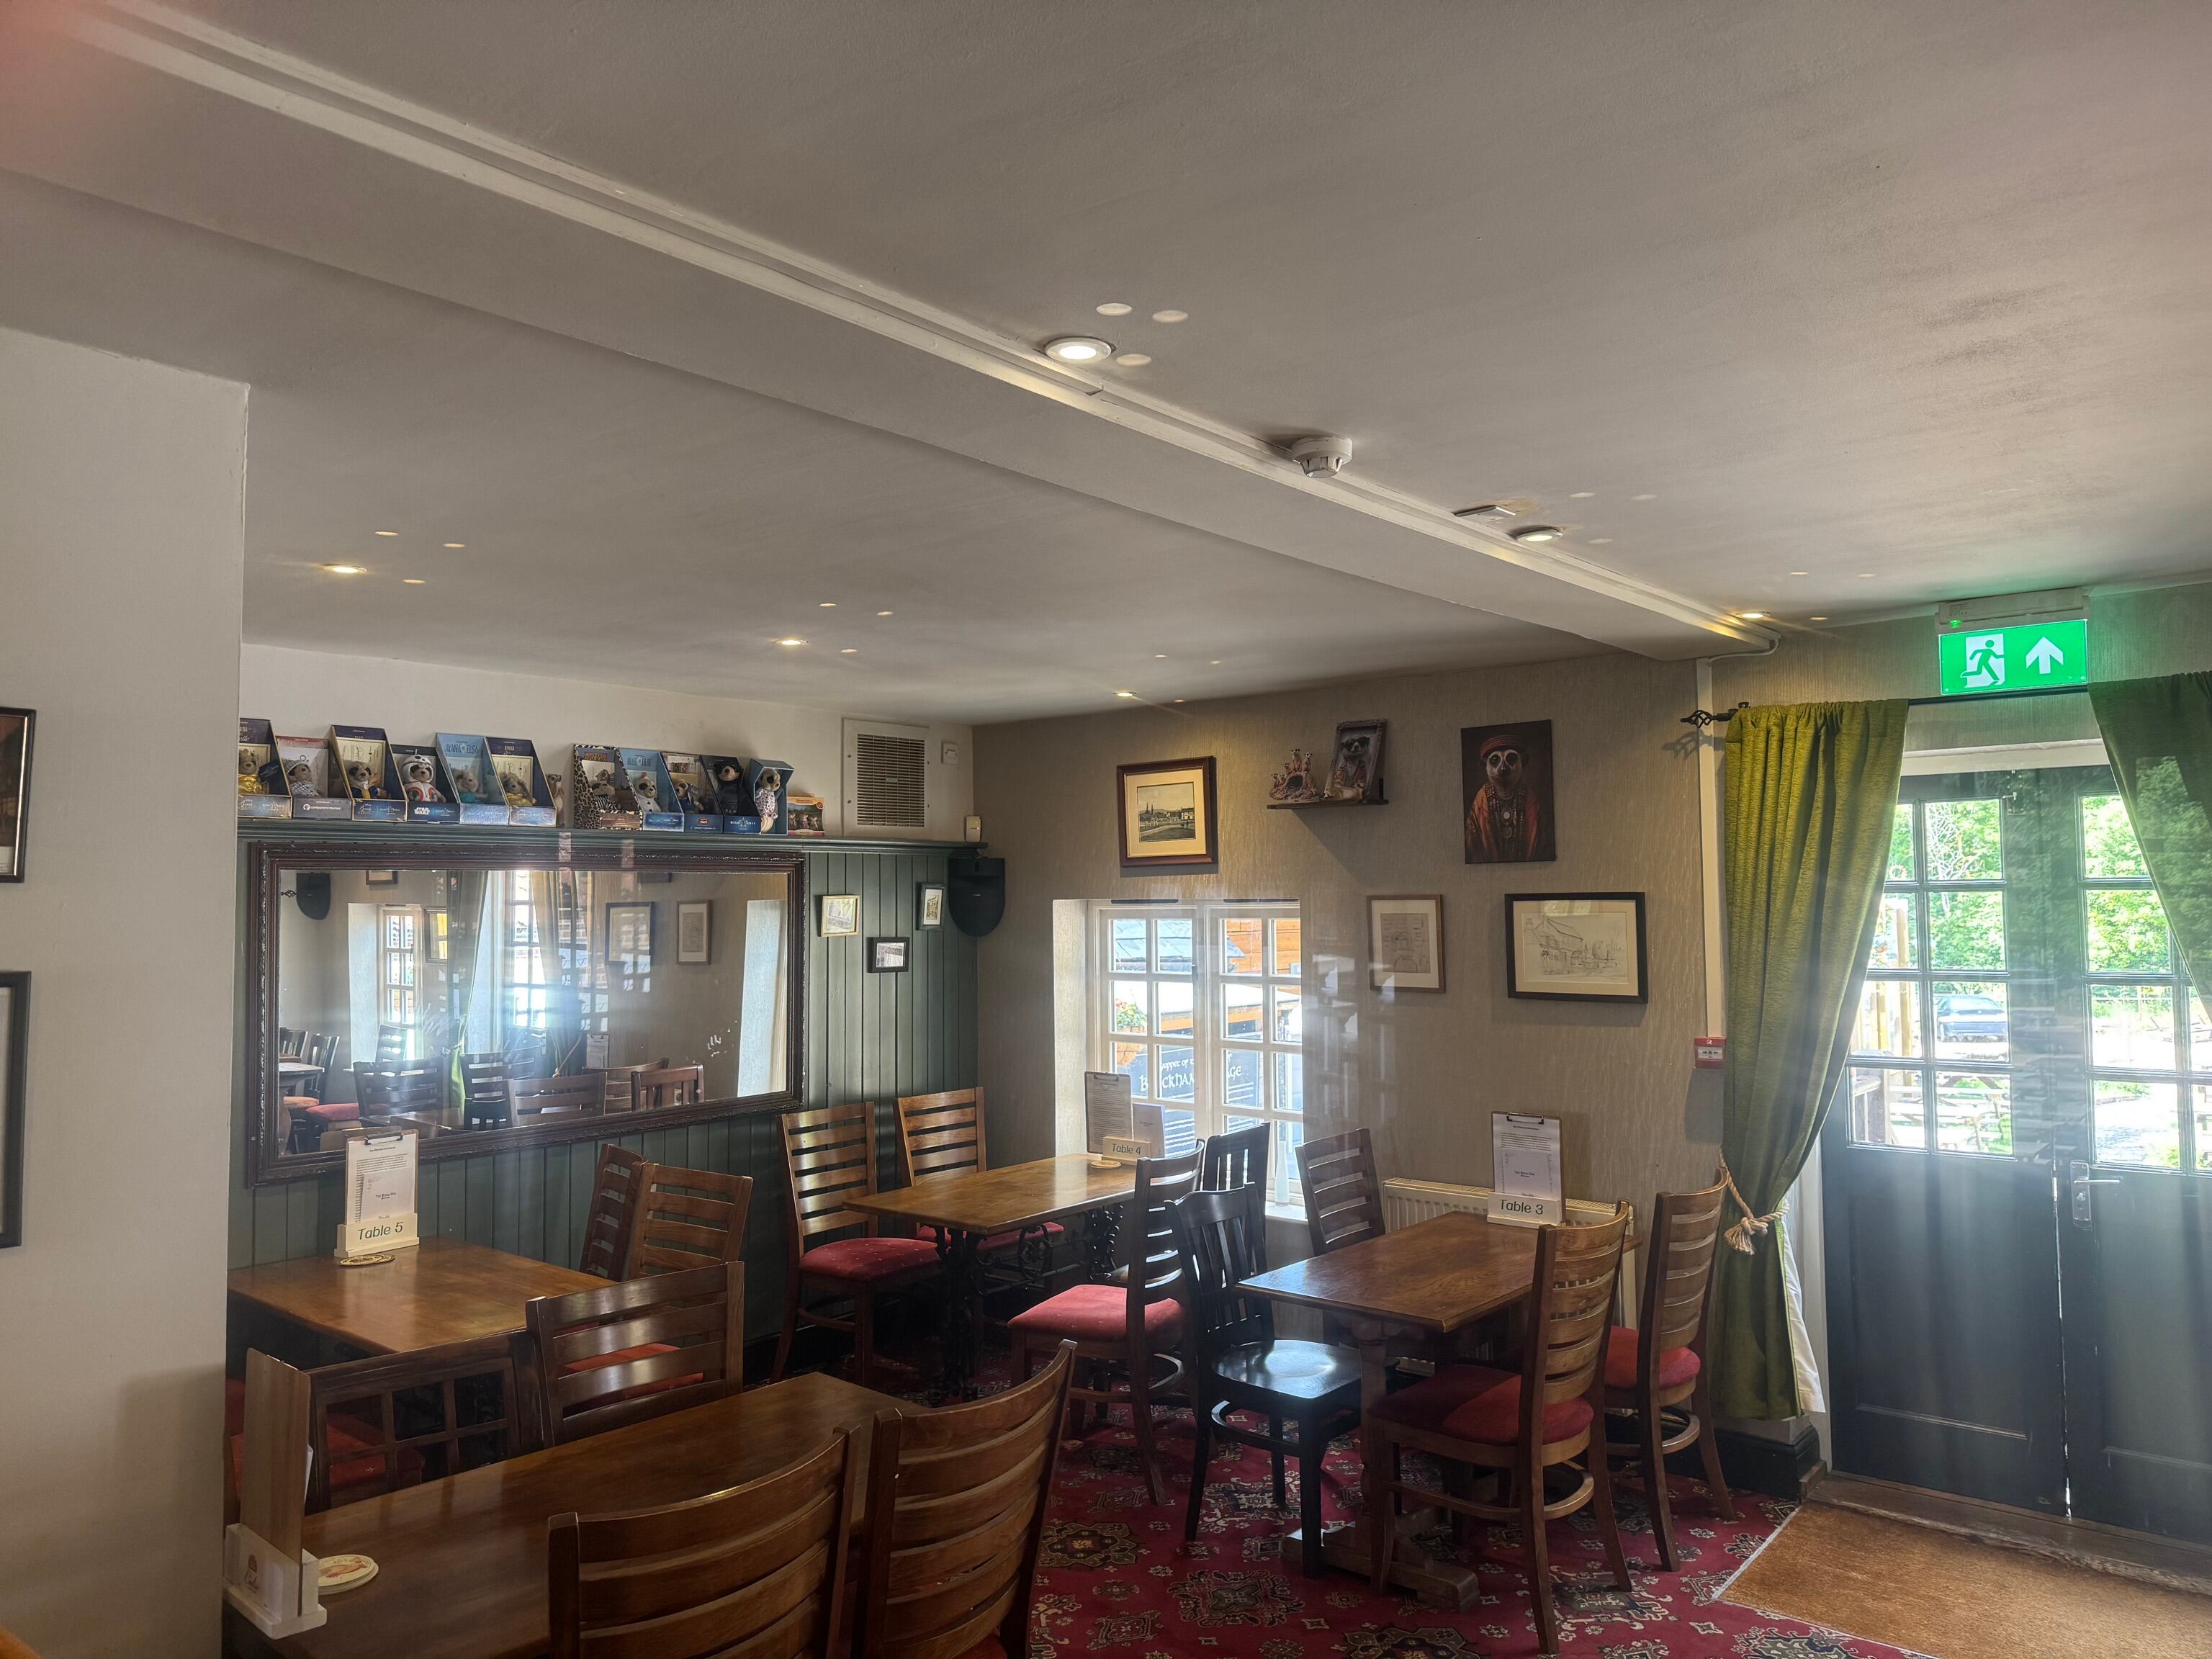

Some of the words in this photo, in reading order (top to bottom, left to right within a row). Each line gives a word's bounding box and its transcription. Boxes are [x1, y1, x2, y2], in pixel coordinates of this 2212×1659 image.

[1112, 1143, 1133, 1154] Table
[1136, 1146, 1141, 1156] 4
[1499, 1199, 1532, 1213] Table
[1535, 1204, 1544, 1215] 3
[358, 1223, 391, 1240] Table
[395, 1221, 404, 1233] 5
